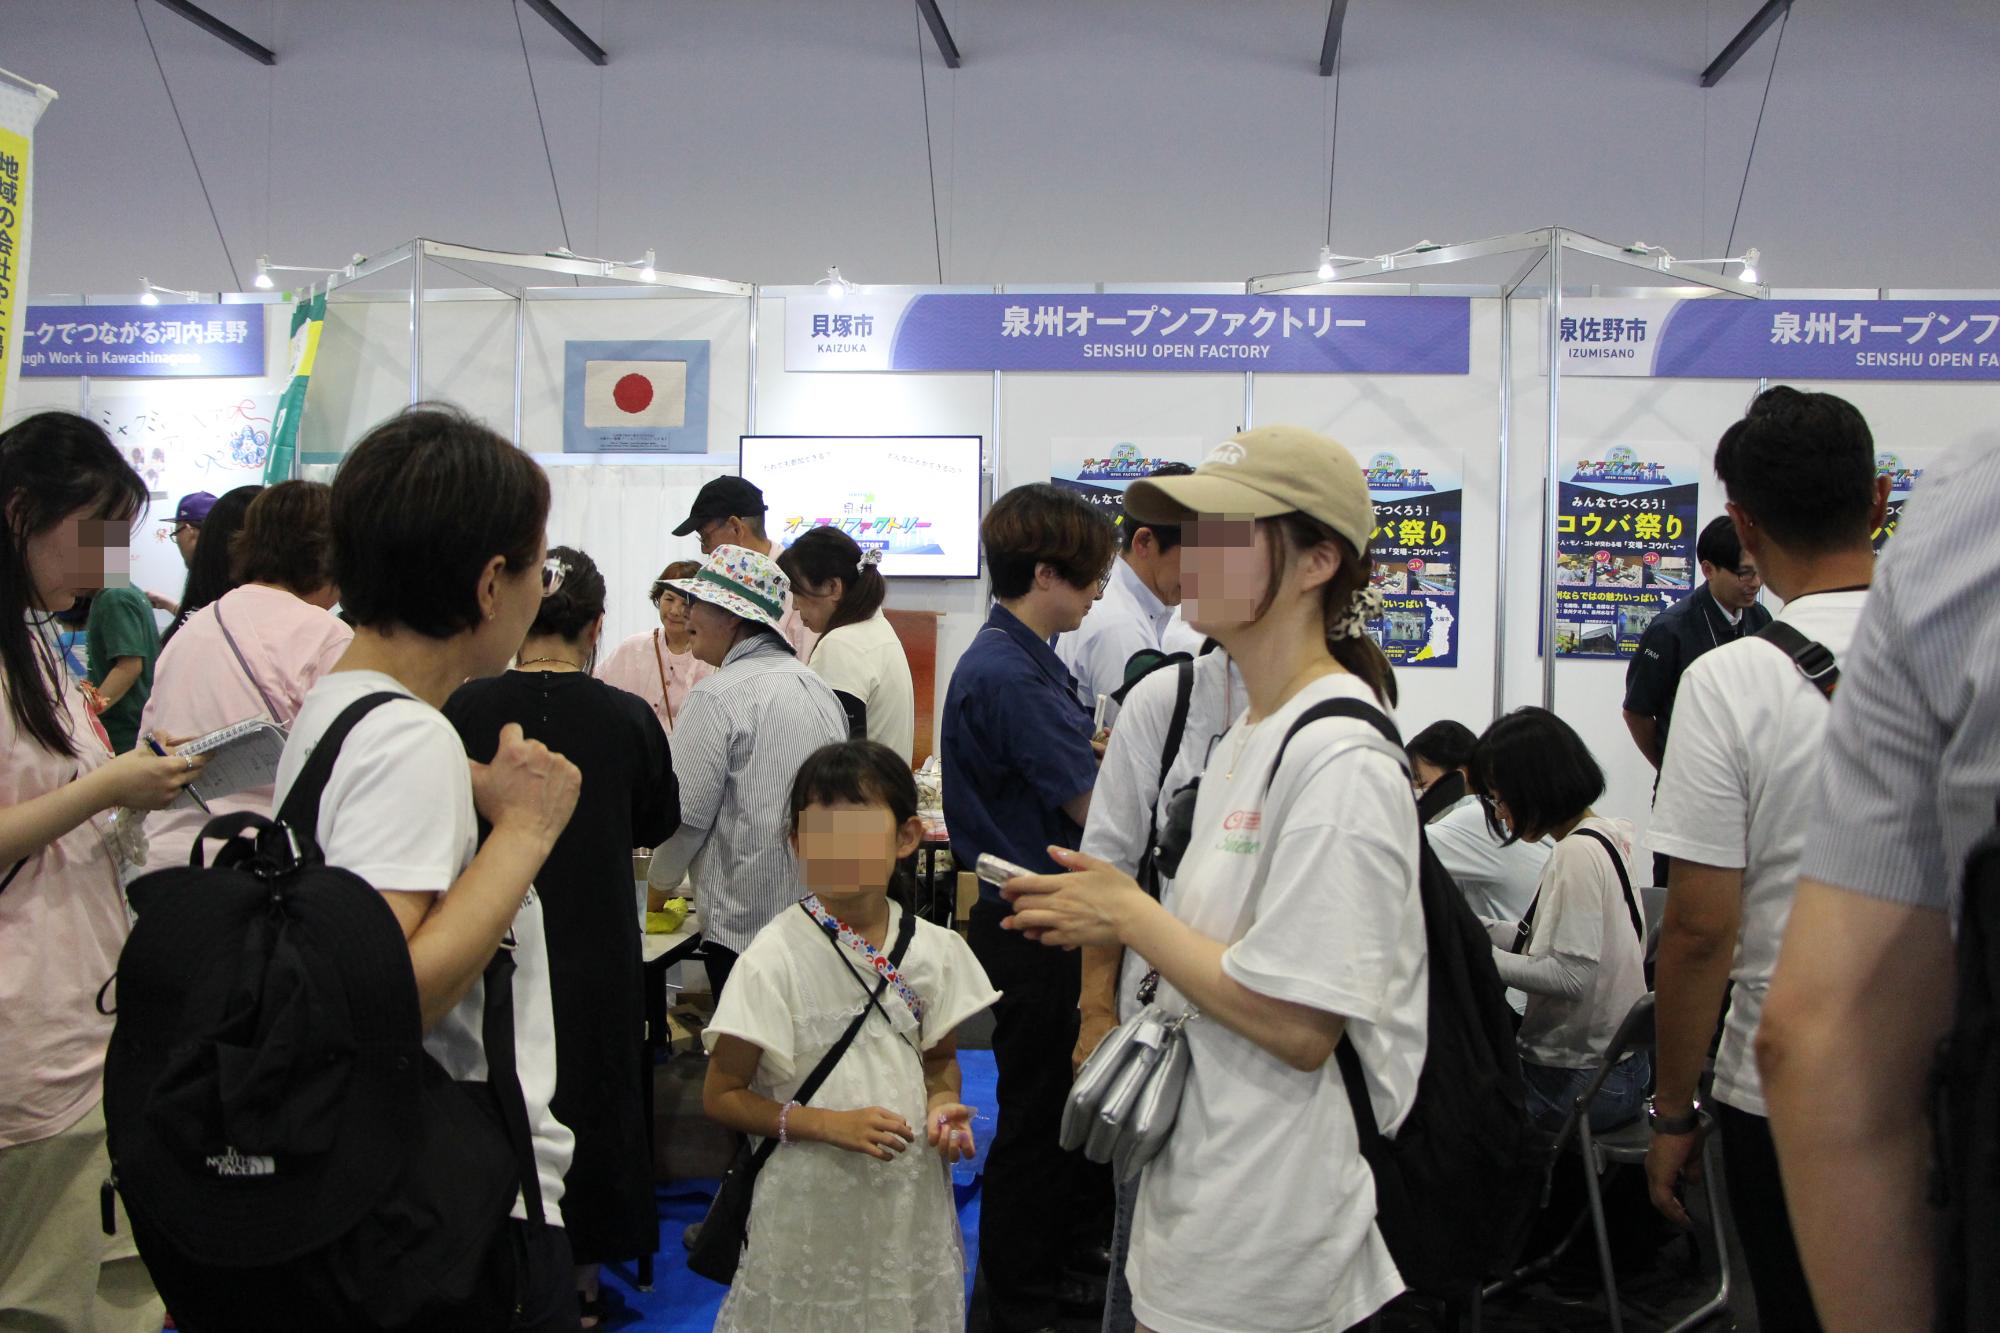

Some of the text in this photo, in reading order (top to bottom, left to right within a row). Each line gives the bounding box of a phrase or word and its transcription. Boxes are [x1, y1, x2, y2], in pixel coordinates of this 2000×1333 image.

[811, 314, 874, 337] 貝塚市
[1001, 305, 1366, 337] 泉州オープンファクトリー
[1770, 311, 1999, 345] 泉州オープンフ
[1560, 317, 1647, 343] 泉佐野市
[818, 344, 867, 353] KAIZUKA
[1083, 344, 1270, 359] SENSHU OPEN FACTORY
[1569, 349, 1635, 359] IZUMISANO
[49, 351, 82, 364] Work
[86, 351, 98, 364] in
[1855, 352, 1923, 366] SENSHU
[1929, 353, 1973, 366] OPEN
[1572, 497, 1666, 510] みんなでつくろう！
[1558, 512, 1683, 540] コウバ祭り
